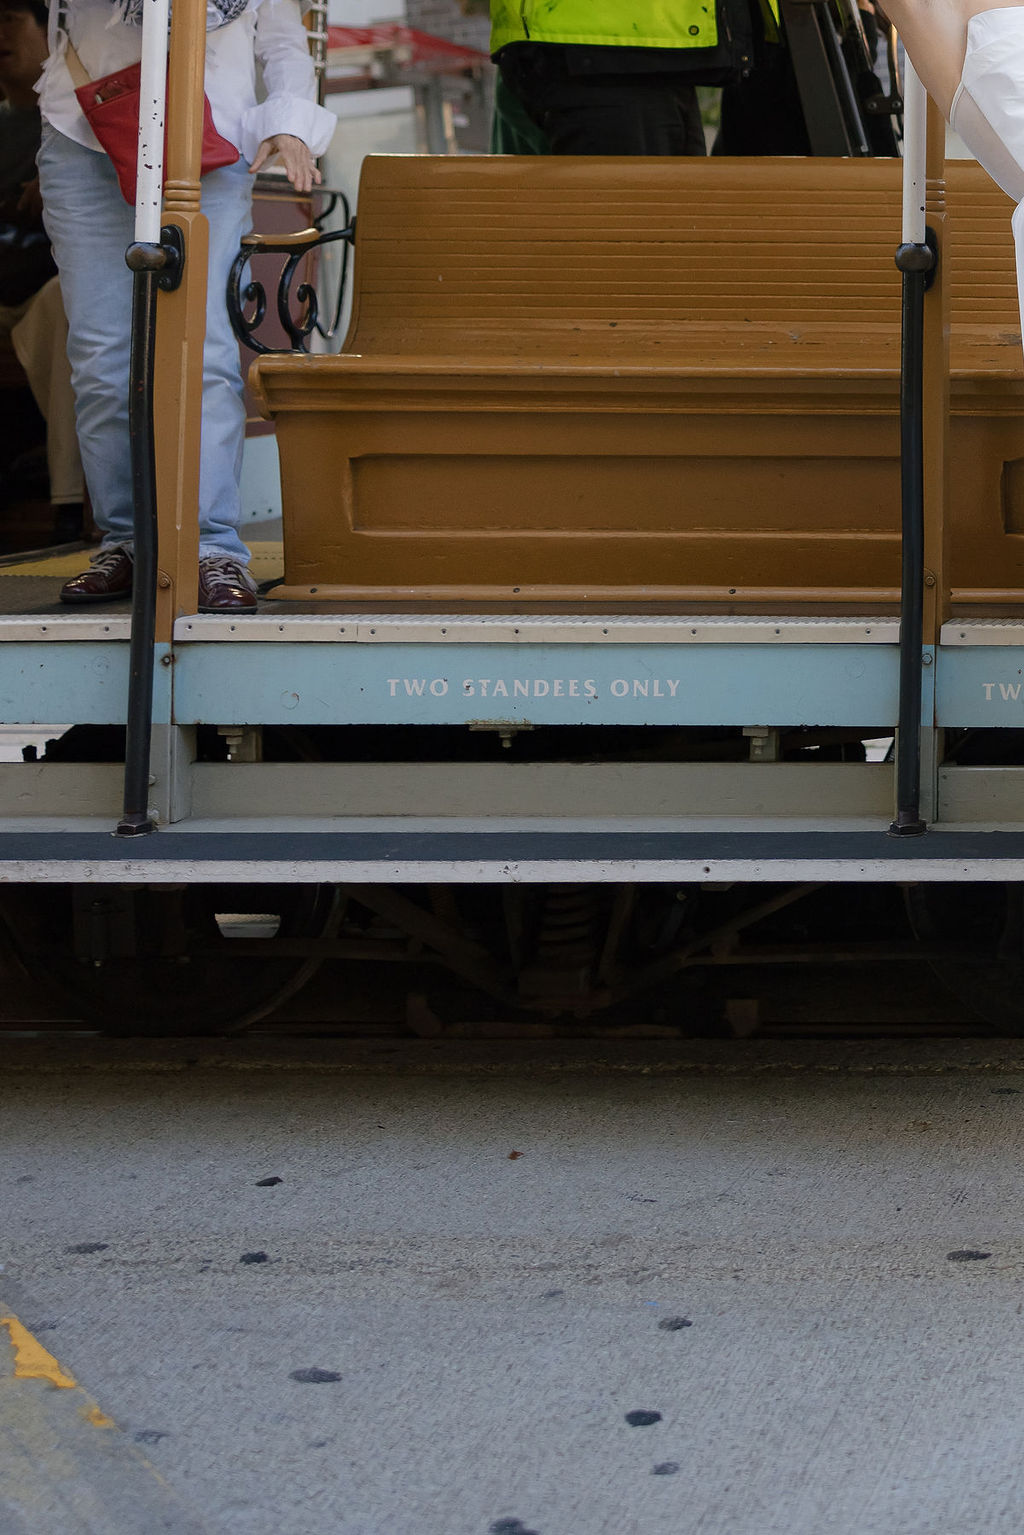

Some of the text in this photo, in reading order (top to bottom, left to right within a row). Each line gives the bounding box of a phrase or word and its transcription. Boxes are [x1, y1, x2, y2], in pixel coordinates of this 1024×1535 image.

[386, 678, 681, 697] TWO STANDEES ONLY
